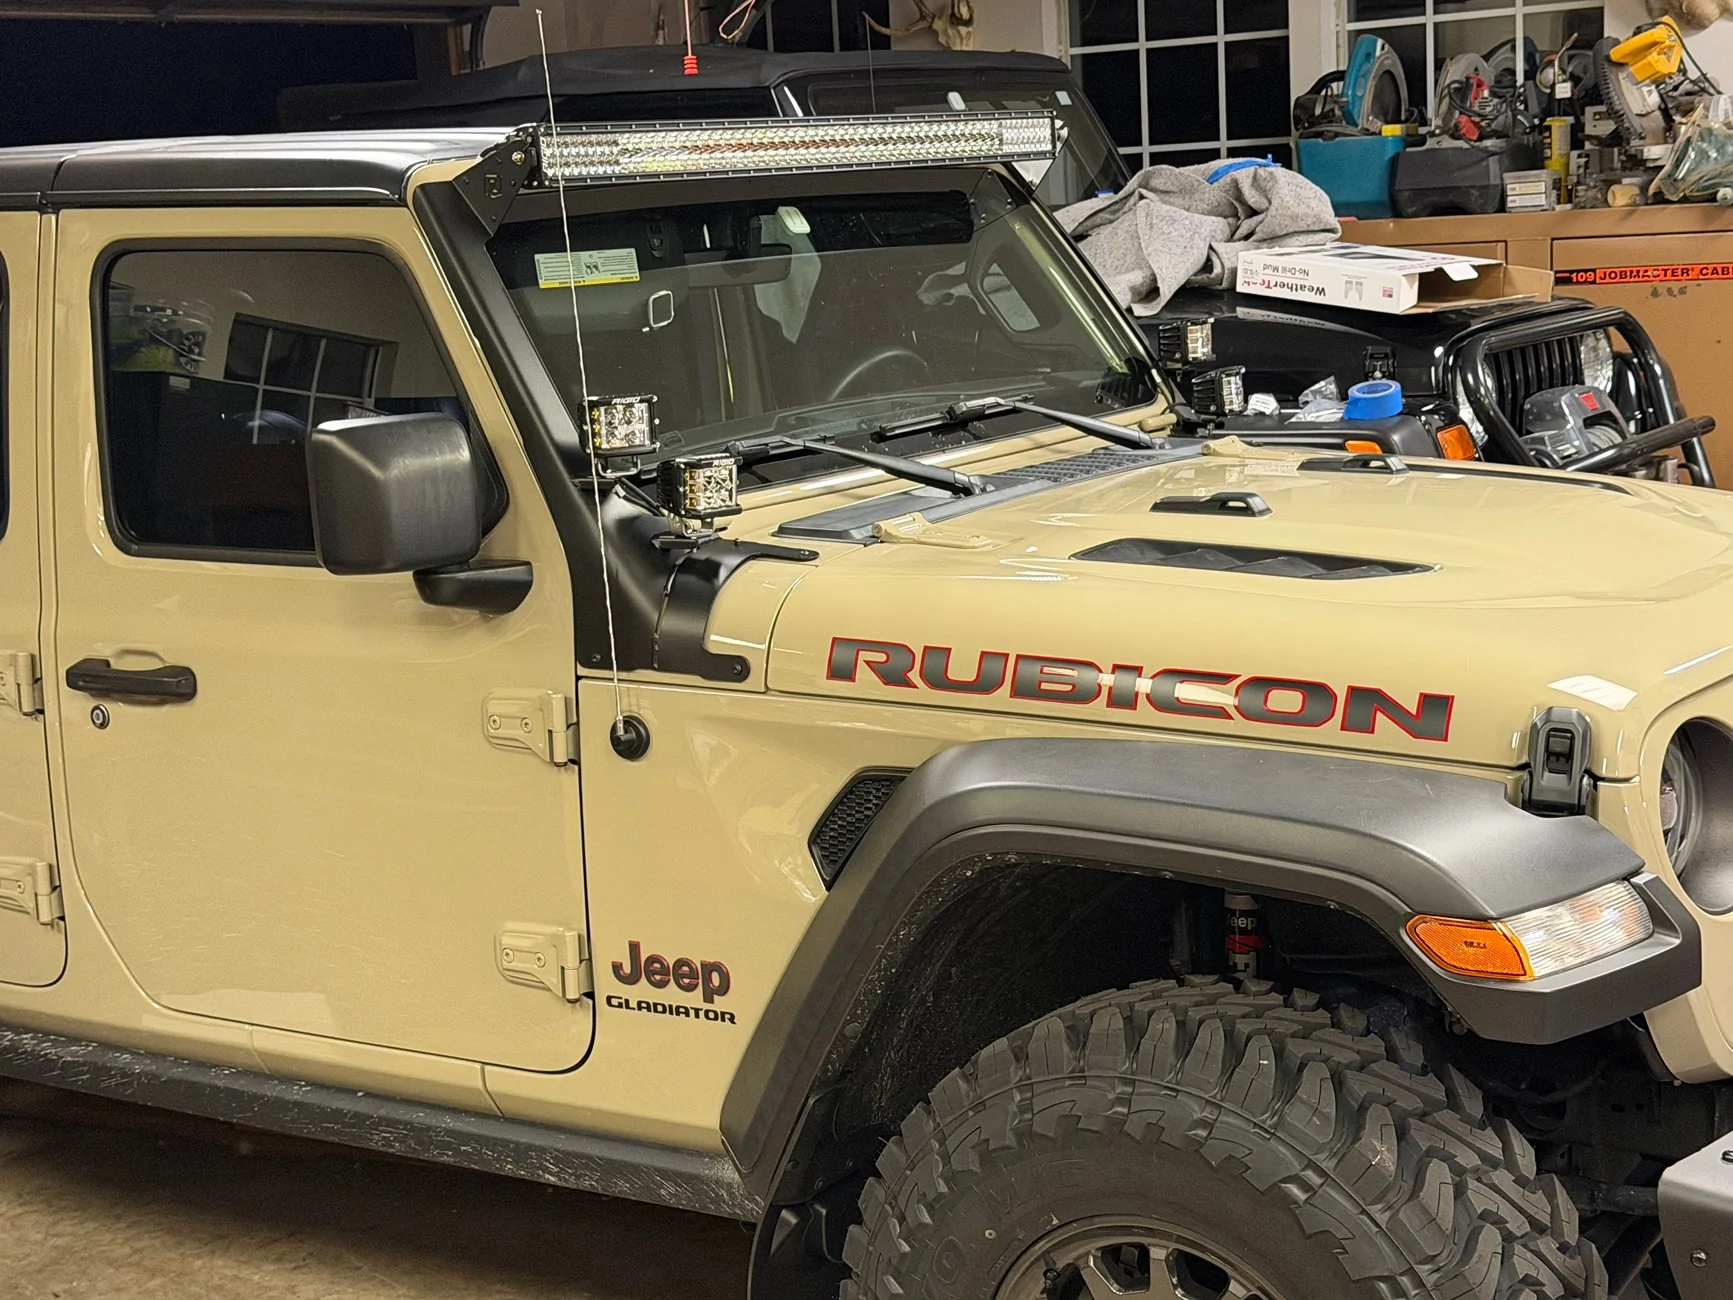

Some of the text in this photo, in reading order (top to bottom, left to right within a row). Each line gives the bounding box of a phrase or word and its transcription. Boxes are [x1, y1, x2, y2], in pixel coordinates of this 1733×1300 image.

[1262, 263, 1280, 274] Mud
[1281, 265, 1309, 277] No-Drill
[1570, 271, 1595, 283] 109
[1699, 265, 1733, 277] CAB
[612, 396, 640, 405] RIGID
[712, 458, 735, 467] RIGID
[825, 636, 1455, 742] RUBICON
[611, 940, 731, 1004] Jeep
[605, 994, 737, 1025] GLADIATOR
